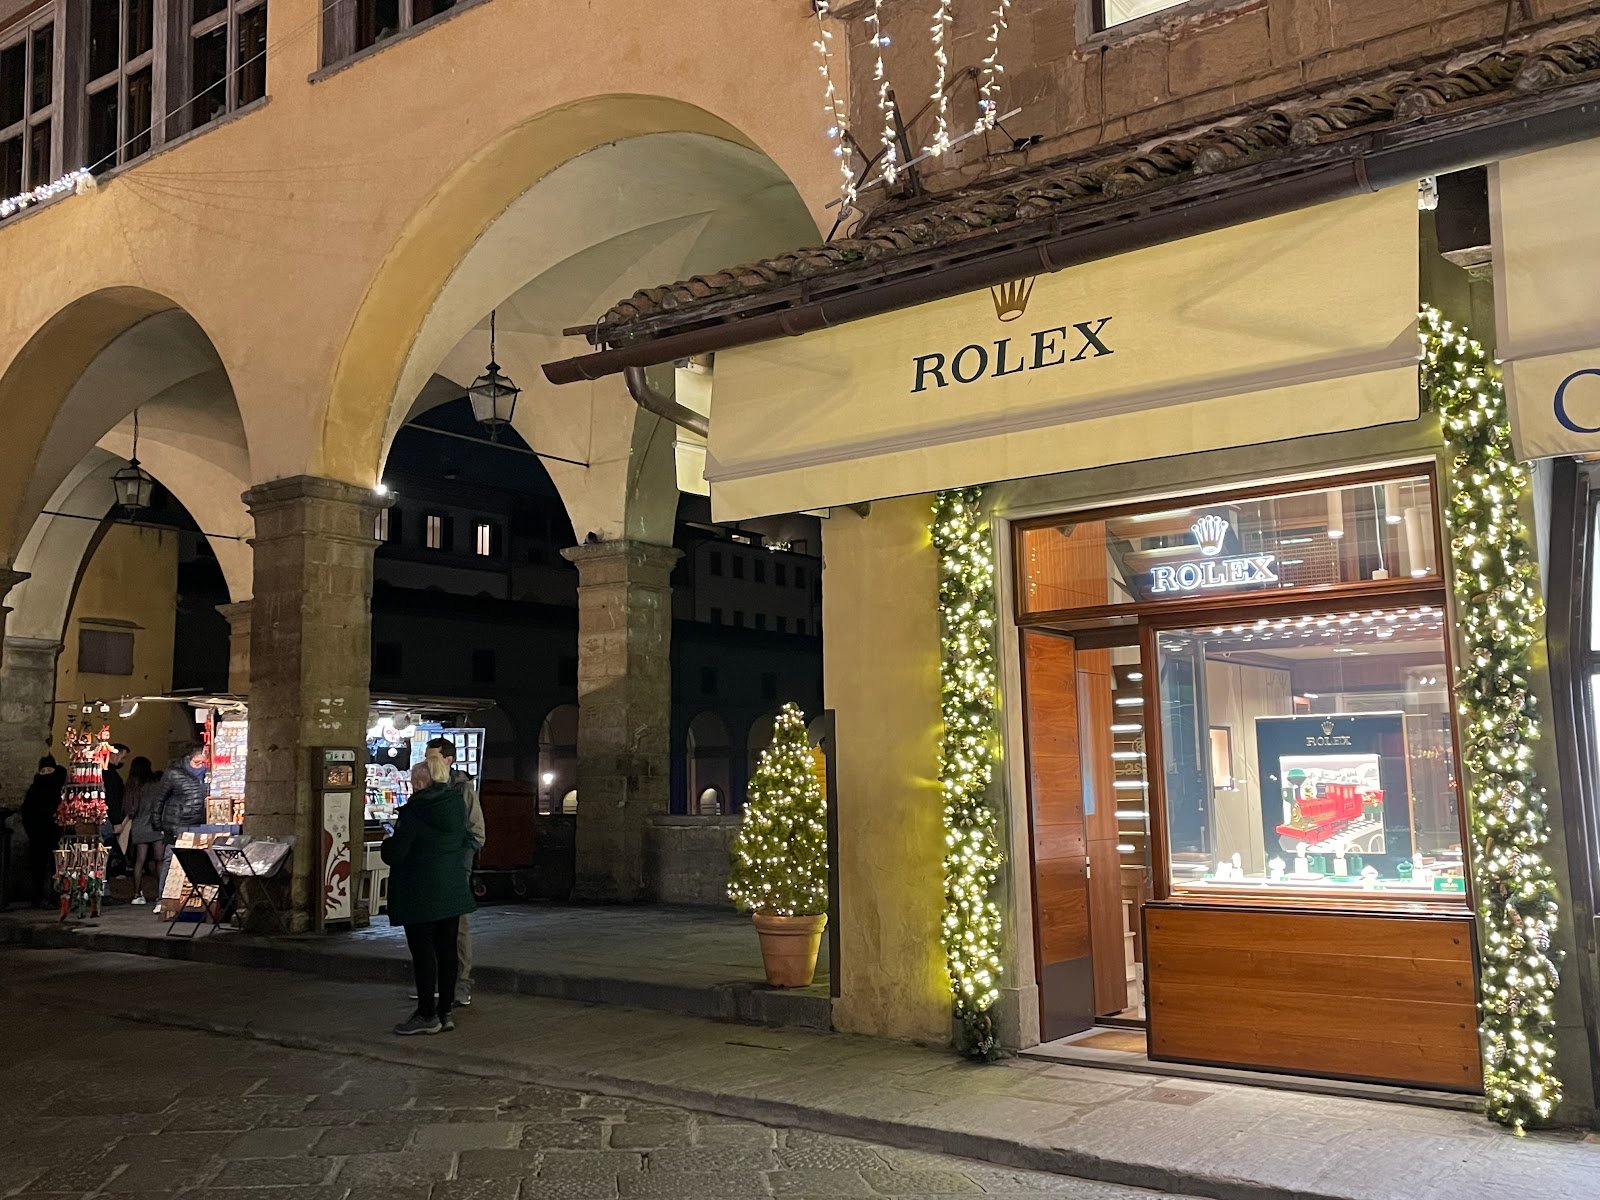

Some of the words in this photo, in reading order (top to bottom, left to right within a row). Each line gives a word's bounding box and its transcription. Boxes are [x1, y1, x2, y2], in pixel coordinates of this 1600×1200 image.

[910, 316, 1115, 393] ROLEX
[1151, 555, 1278, 593] ROLEX
[1305, 735, 1352, 747] ROLEX
